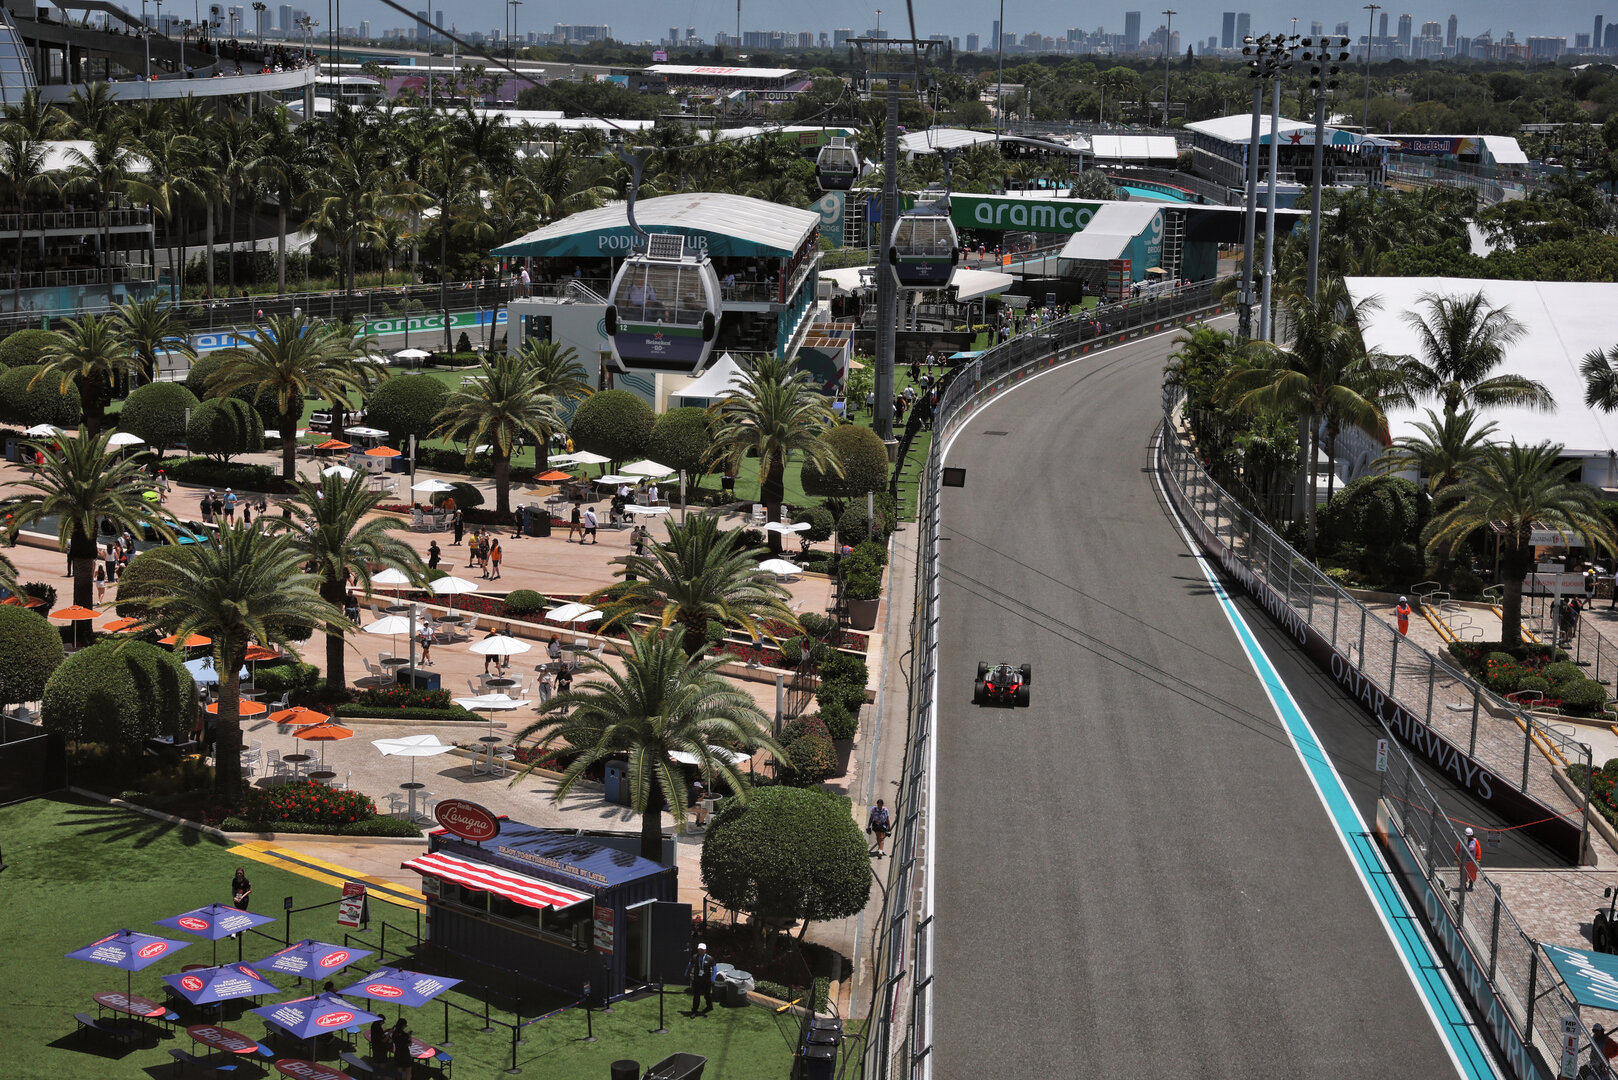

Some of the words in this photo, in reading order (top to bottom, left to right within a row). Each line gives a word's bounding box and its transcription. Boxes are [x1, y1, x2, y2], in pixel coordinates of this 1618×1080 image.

[764, 92, 788, 100] LOUIS
[820, 193, 841, 224] 9
[974, 202, 1094, 228] aramco
[1152, 212, 1163, 245] 9
[599, 235, 648, 249] PODIU
[358, 315, 458, 333] ramco
[1221, 547, 1254, 595] QATAR
[1256, 583, 1307, 645] AIRWAYS
[1331, 652, 1385, 718] QATAR
[1389, 706, 1493, 800] AIRWAYS
[441, 806, 489, 831] Lasagna
[1424, 888, 1482, 1009] QATAR
[101, 994, 154, 1016] Barilla
[193, 1027, 247, 1051] Barilla
[281, 1062, 340, 1080] Barill
